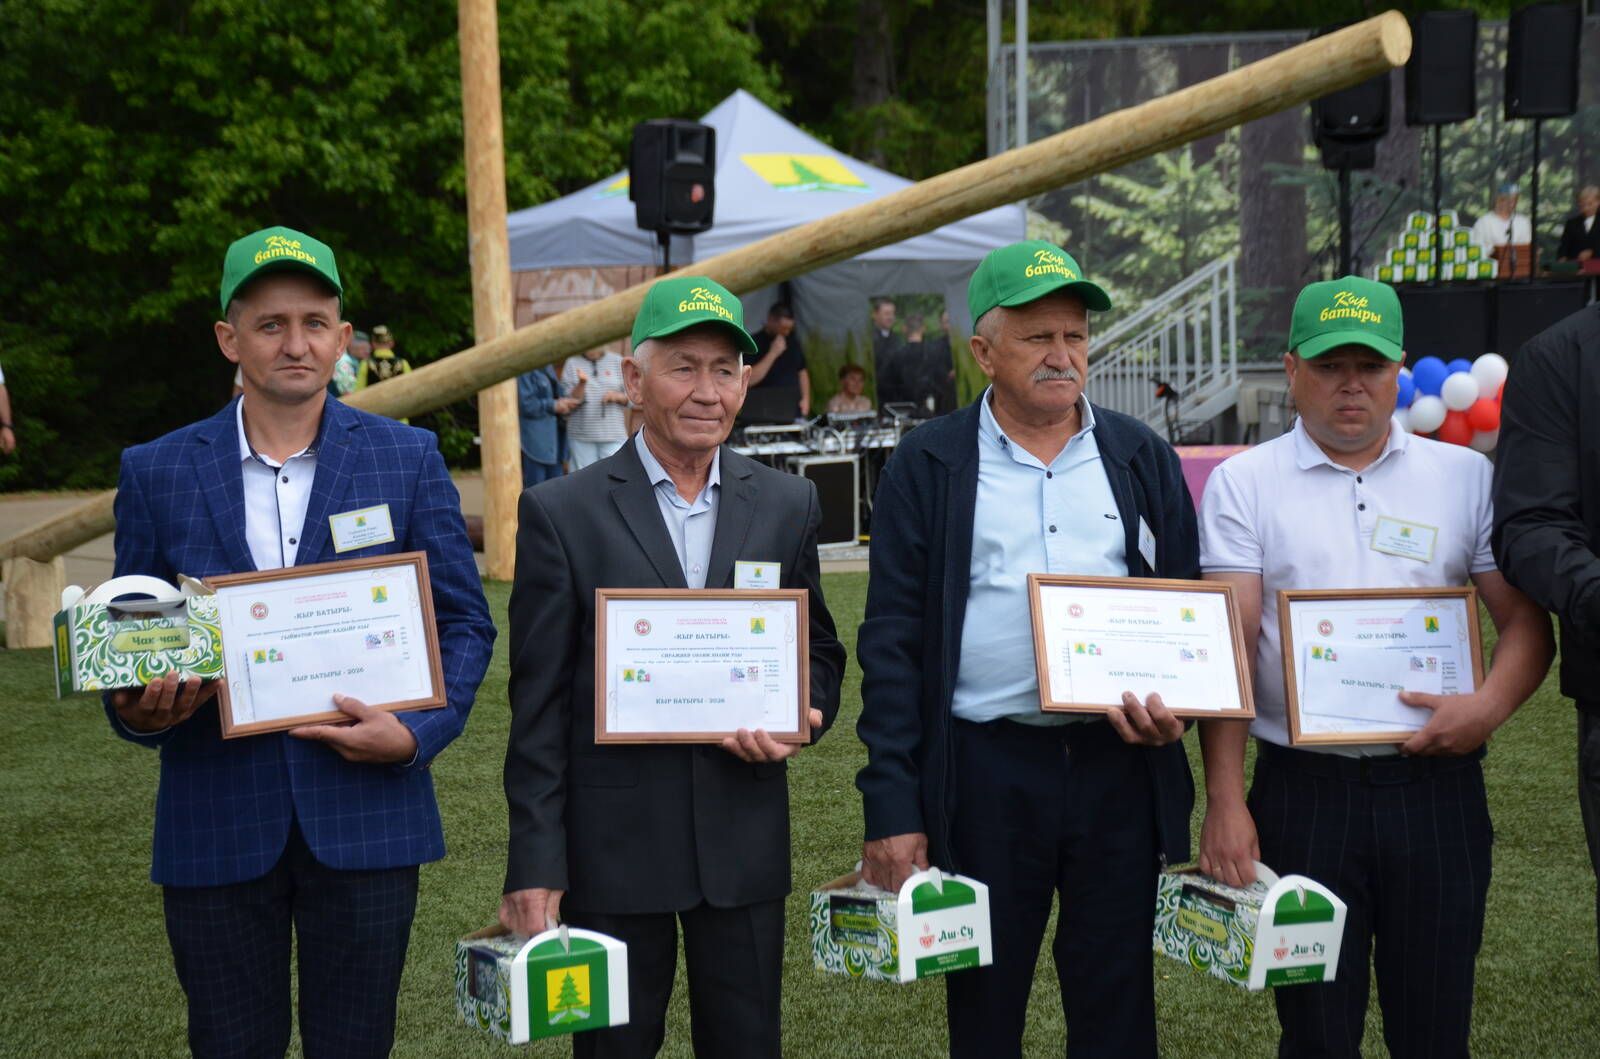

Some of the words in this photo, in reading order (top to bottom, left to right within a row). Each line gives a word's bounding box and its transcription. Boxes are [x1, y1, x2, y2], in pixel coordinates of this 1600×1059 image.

[264, 235, 301, 249] Кыр
[254, 249, 317, 264] батыры
[1034, 249, 1065, 265] Кыр
[1025, 264, 1077, 280] батыры
[690, 287, 722, 304] Кыр
[1333, 290, 1369, 309] Кыр
[678, 300, 733, 320] батыры
[1320, 307, 1382, 323] батыры
